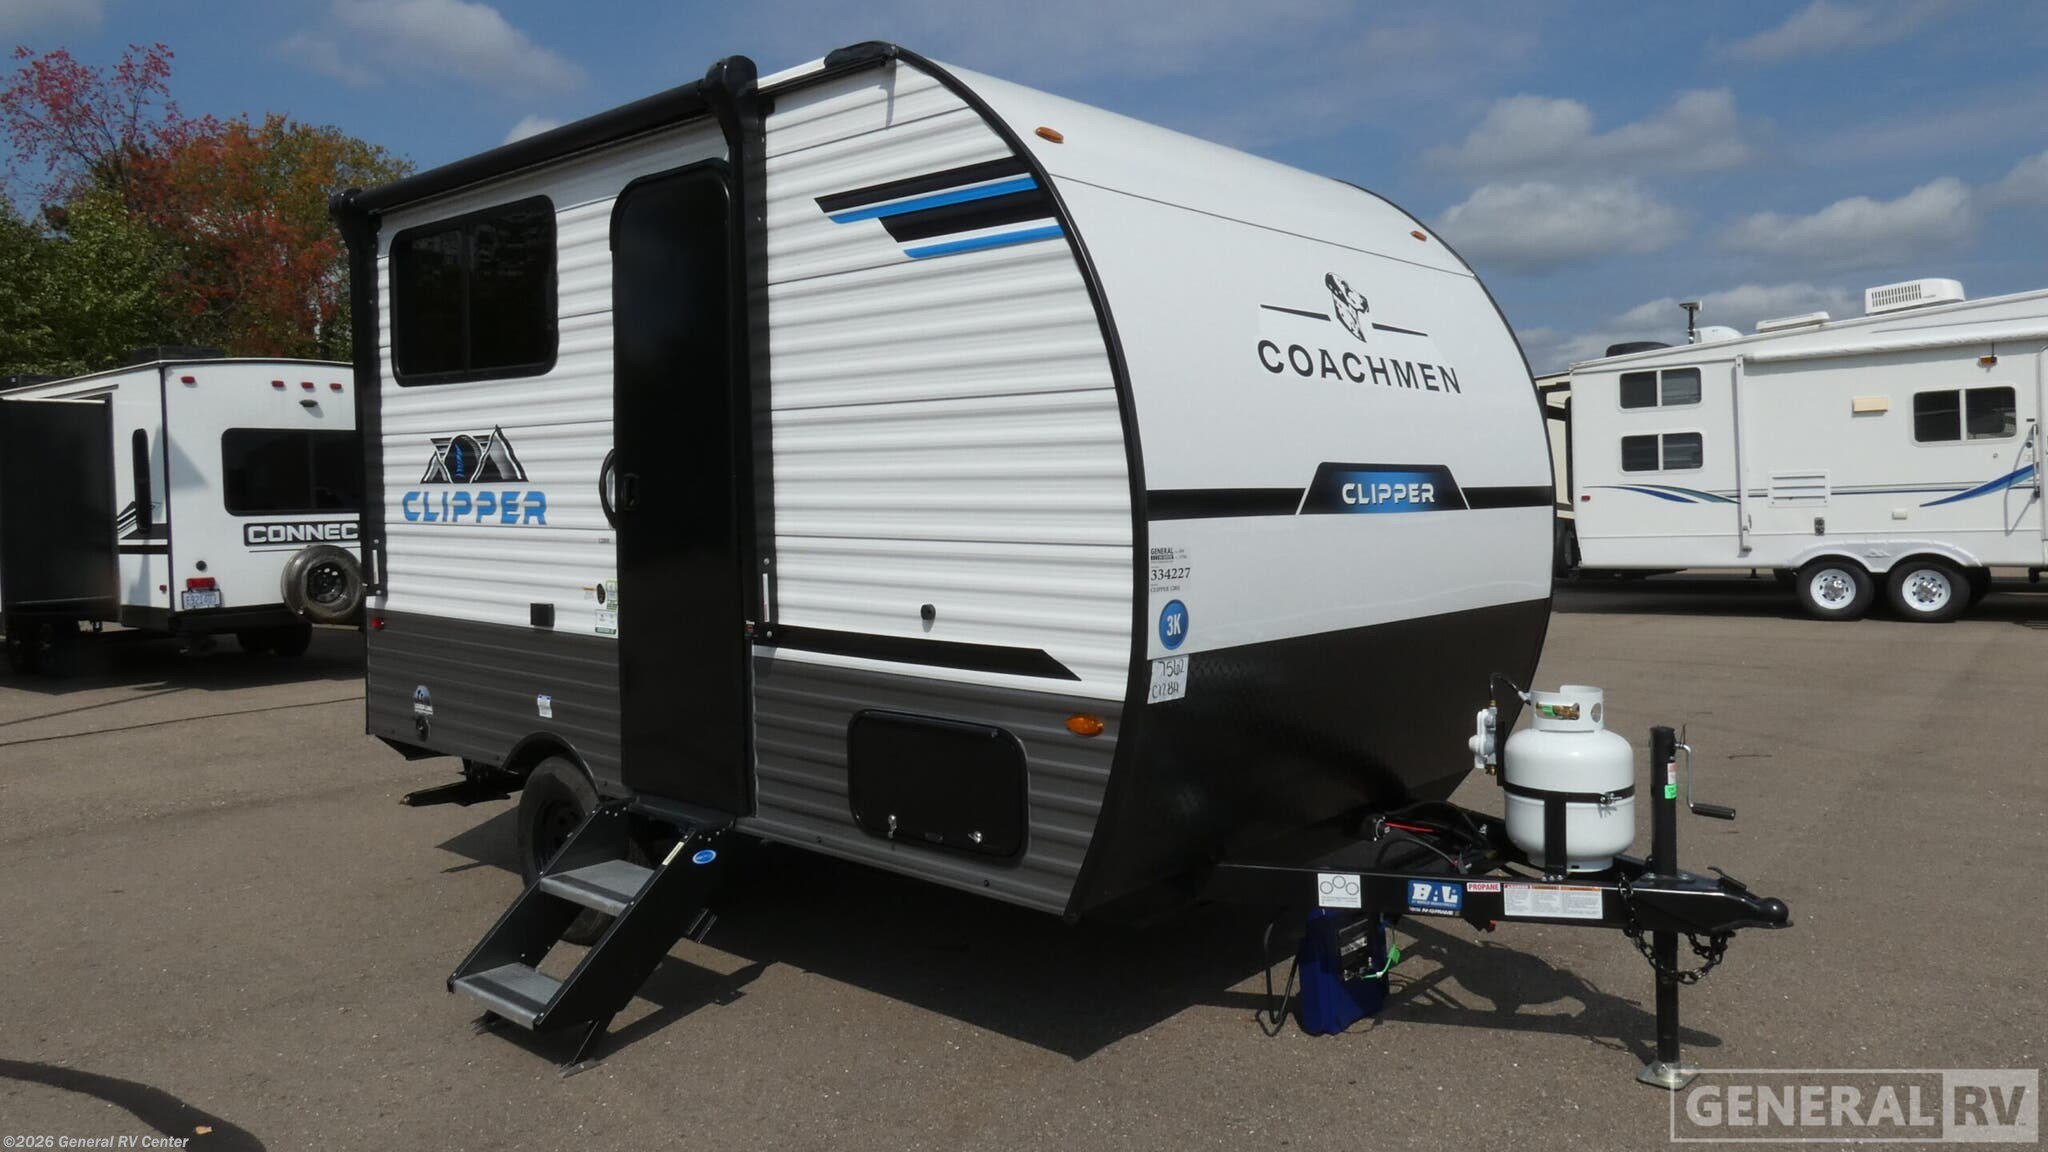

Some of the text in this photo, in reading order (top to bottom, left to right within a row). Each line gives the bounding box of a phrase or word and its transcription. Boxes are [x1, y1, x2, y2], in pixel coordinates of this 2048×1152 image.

[1257, 339, 1461, 394] COACHMEN
[1341, 483, 1435, 504] CLIPPER
[402, 491, 547, 525] CLIPPER
[1151, 567, 1191, 580] 334227
[1166, 612, 1182, 637] 3K
[1469, 883, 1498, 891] PROPANE
